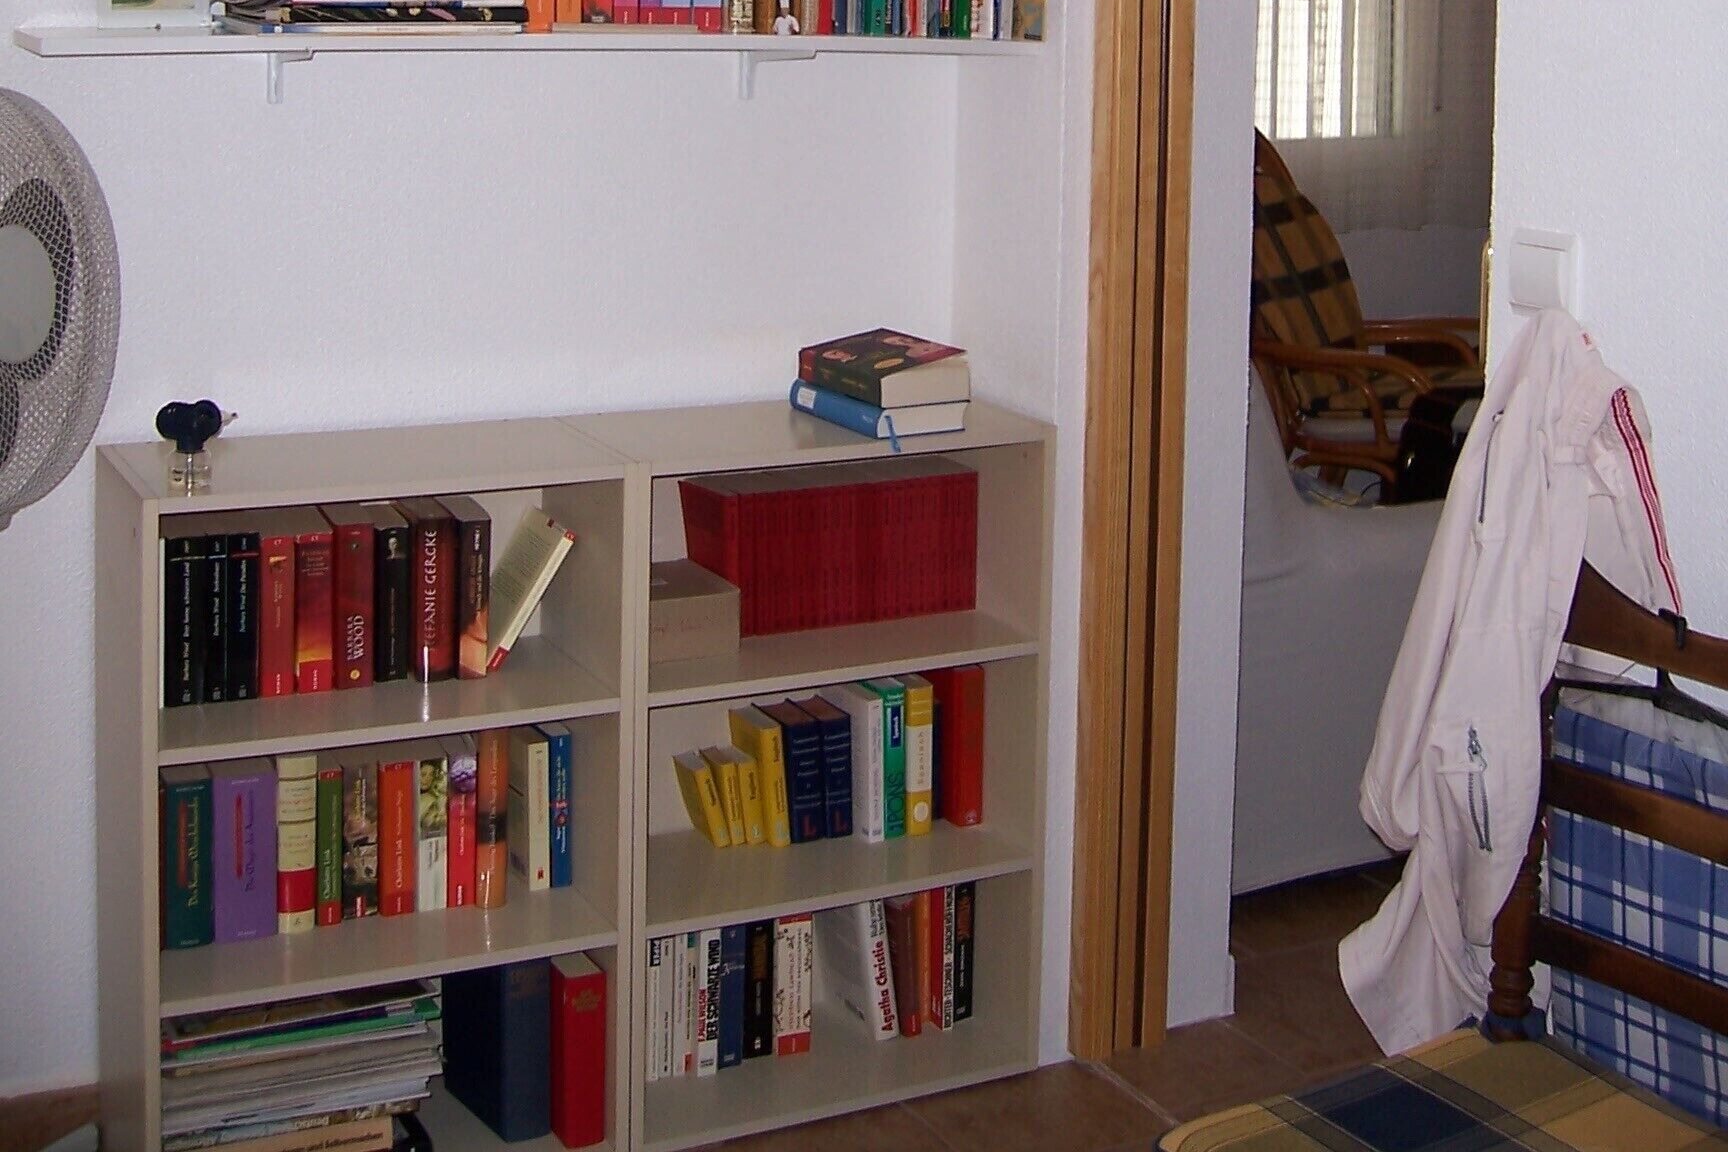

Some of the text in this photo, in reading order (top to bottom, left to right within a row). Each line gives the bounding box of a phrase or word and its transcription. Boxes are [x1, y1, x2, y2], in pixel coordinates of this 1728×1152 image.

[423, 529, 438, 585] GERCKE
[353, 614, 365, 659] WOOD
[886, 772, 905, 824] PONS
[707, 939, 721, 965] WIND
[871, 940, 889, 987] Christie
[706, 966, 721, 1020] SCHWARZE
[878, 988, 895, 1032] Agatha
